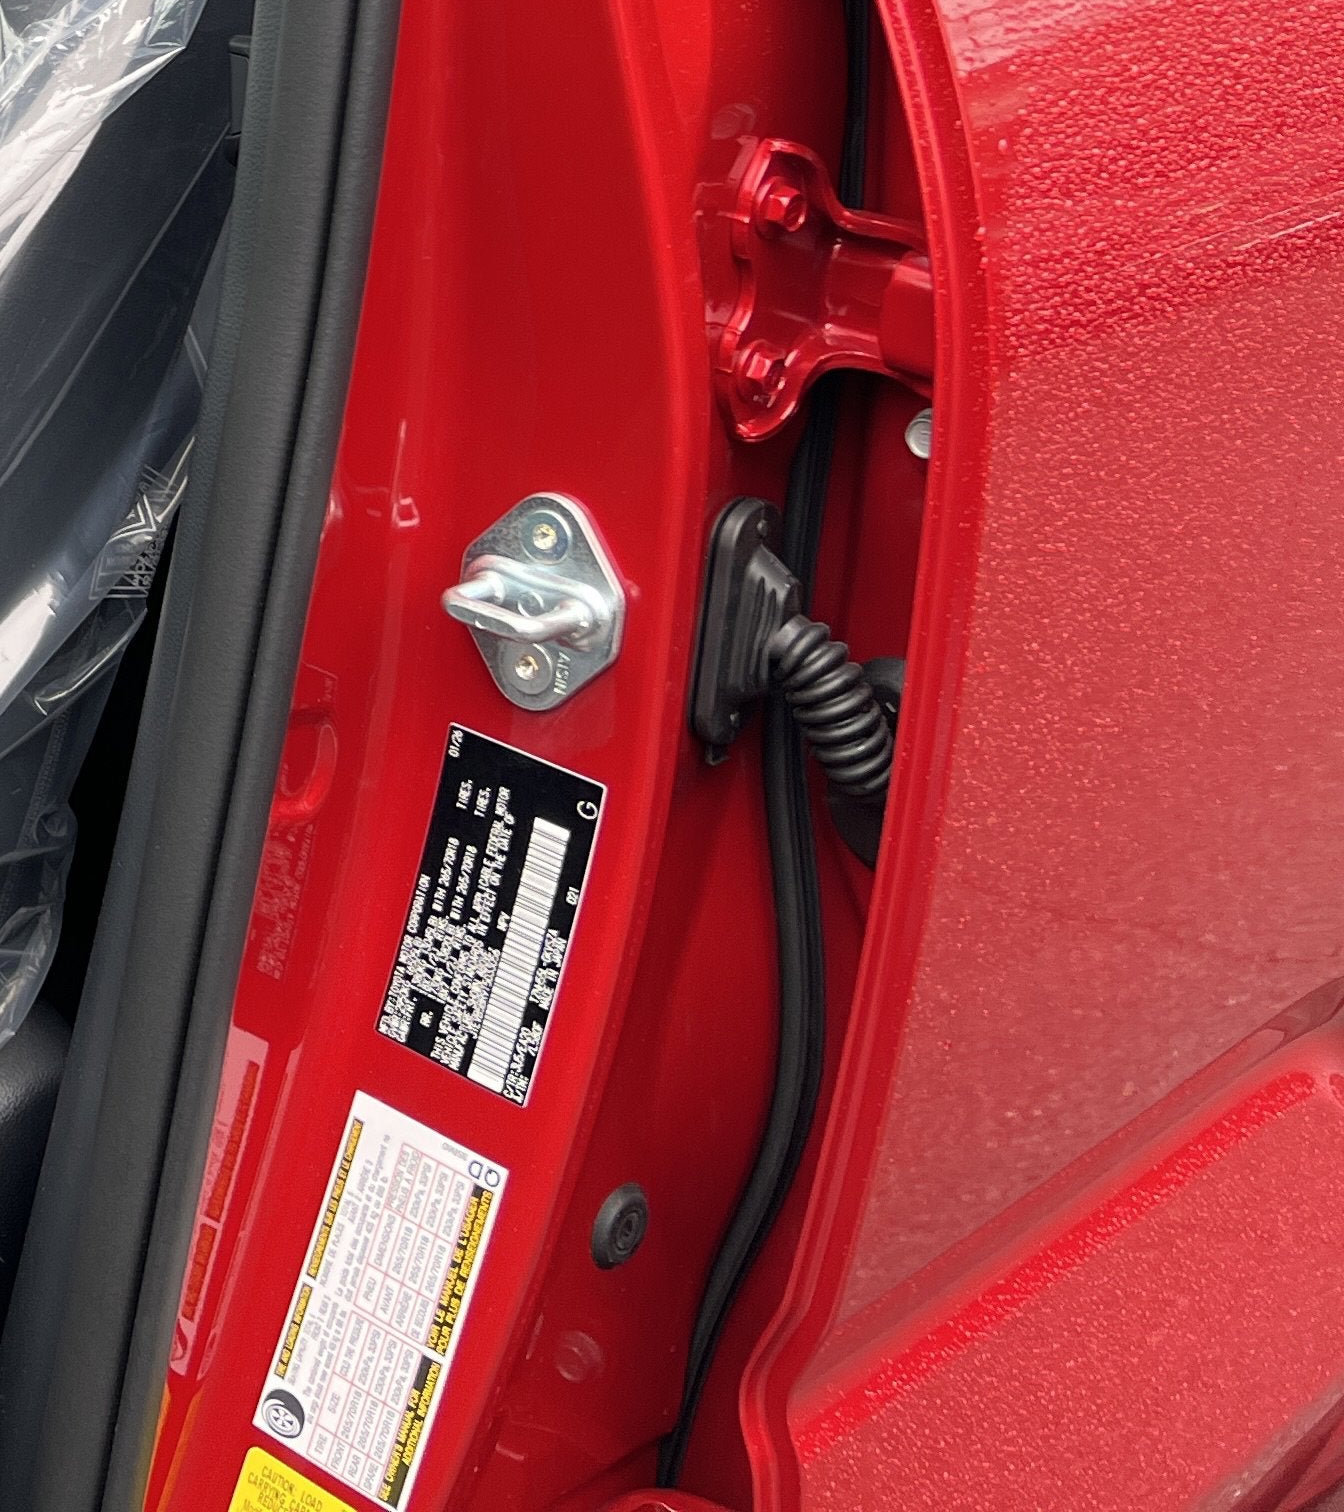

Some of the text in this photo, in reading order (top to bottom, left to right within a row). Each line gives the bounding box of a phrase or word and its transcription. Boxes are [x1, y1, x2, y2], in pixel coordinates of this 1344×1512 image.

[446, 727, 465, 759] 01/26
[455, 775, 474, 811] TIRES.
[473, 783, 492, 819] TIRES.
[493, 784, 511, 818] MOTOR
[574, 797, 599, 822] G
[502, 809, 516, 826] OF
[484, 817, 504, 858] FEDERAL
[496, 825, 513, 852] DATE
[437, 834, 460, 888] 265/70R18
[455, 842, 478, 896] 265/70R18
[488, 870, 502, 887] ON
[492, 851, 507, 871] THE
[406, 872, 430, 935] CORPORATION
[430, 885, 447, 913] WITH
[448, 893, 465, 921] WITH
[479, 887, 498, 923] EFFECT
[466, 914, 480, 934] ALL
[430, 1034, 445, 1061] THIS
[385, 1148, 410, 1208] PRESSION DES
[435, 1188, 493, 1356] POUR PLUS DE RENSEIGNEMENTS
[451, 1246, 464, 1264] DE
[438, 1263, 459, 1307] MANUEL
[433, 1306, 446, 1324] LE
[314, 1432, 328, 1455] TIRE
[327, 1391, 340, 1414] SIZE
[362, 1275, 377, 1302] PNEU
[373, 1212, 396, 1267] DIMENSIONS
[330, 1439, 346, 1471] FRONT
[340, 1388, 363, 1440] 265/70R18
[379, 1284, 395, 1315] AVANT
[391, 1224, 414, 1276] 265/70R18
[372, 1408, 395, 1460] 265/70R18
[424, 1243, 447, 1294] 265/70R18
[425, 1322, 441, 1350] VOIR
[347, 1453, 361, 1478] REAR
[356, 1398, 379, 1450] 265/70R18
[407, 1233, 430, 1285] 265/70R18
[400, 1359, 441, 1467] ADDITIONAL INFORMATION
[378, 1481, 392, 1502] SEE
[395, 1406, 415, 1444] MANUAL
[406, 1386, 421, 1409] FOR
[245, 1471, 290, 1506] CARRYING
[259, 1465, 299, 1497] CAUTION:
[298, 1490, 326, 1512] LOAD
